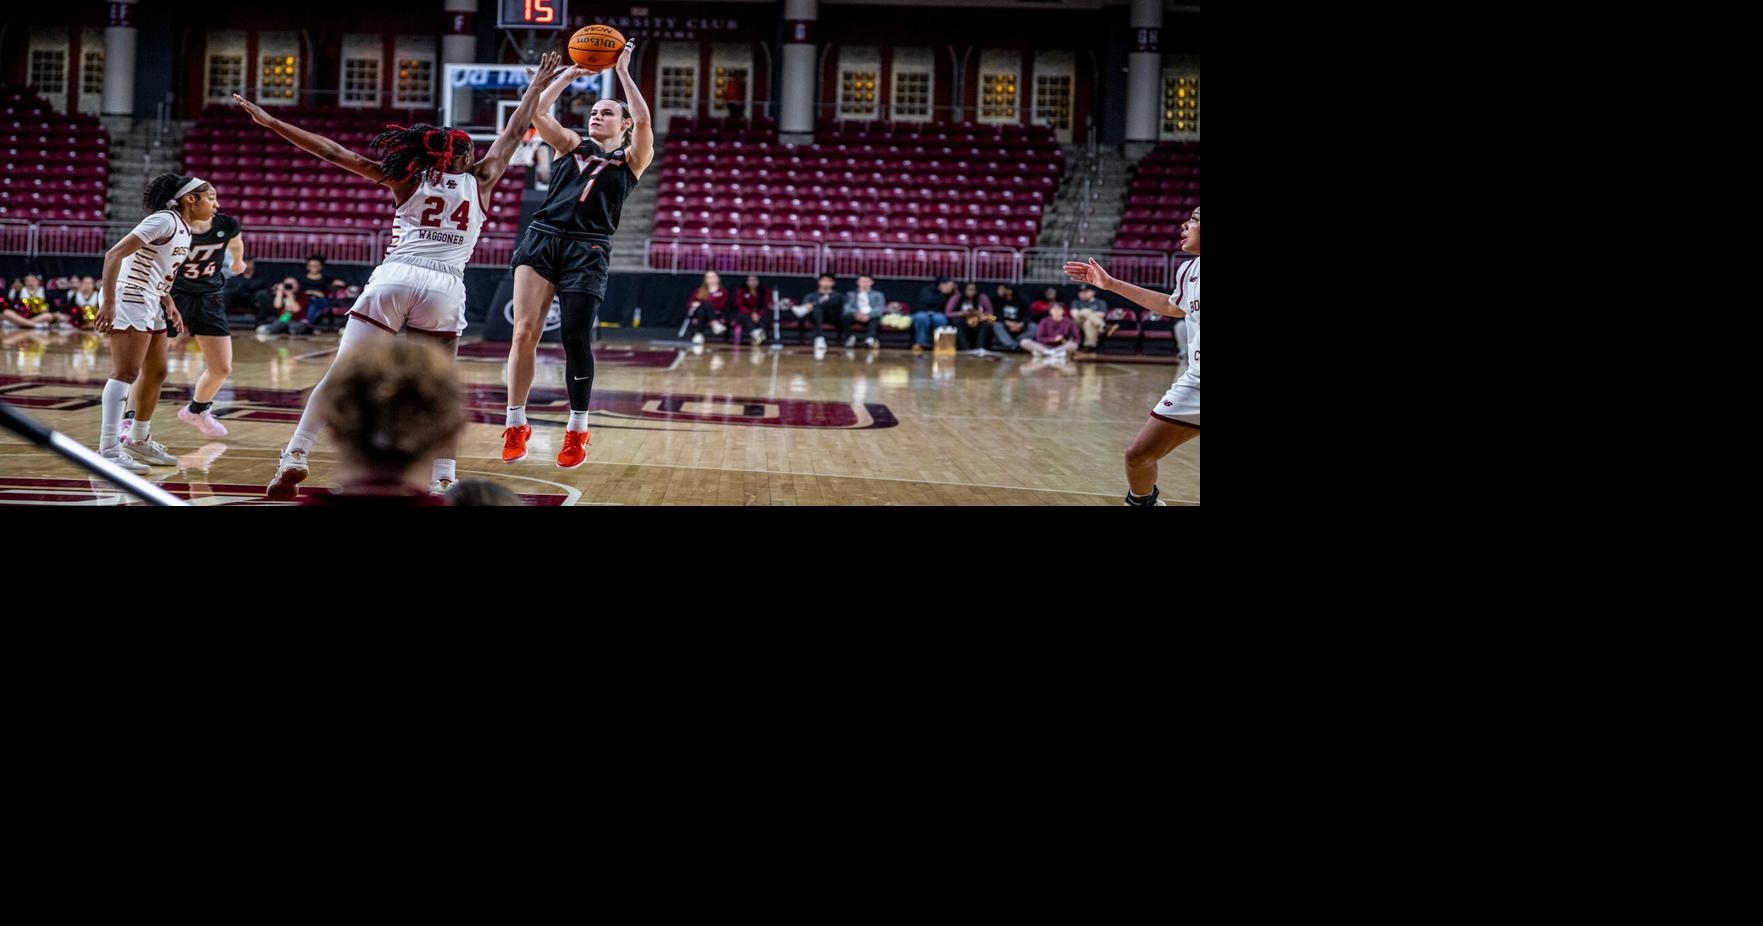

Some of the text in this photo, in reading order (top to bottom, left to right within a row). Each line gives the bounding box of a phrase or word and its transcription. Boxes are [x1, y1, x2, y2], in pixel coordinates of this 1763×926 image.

[524, 0, 554, 22] 15
[594, 16, 678, 29] VARSITY
[685, 18, 739, 30] CLUB
[578, 178, 597, 204] 1
[420, 195, 470, 232] 24
[418, 229, 464, 246] WAGGONER
